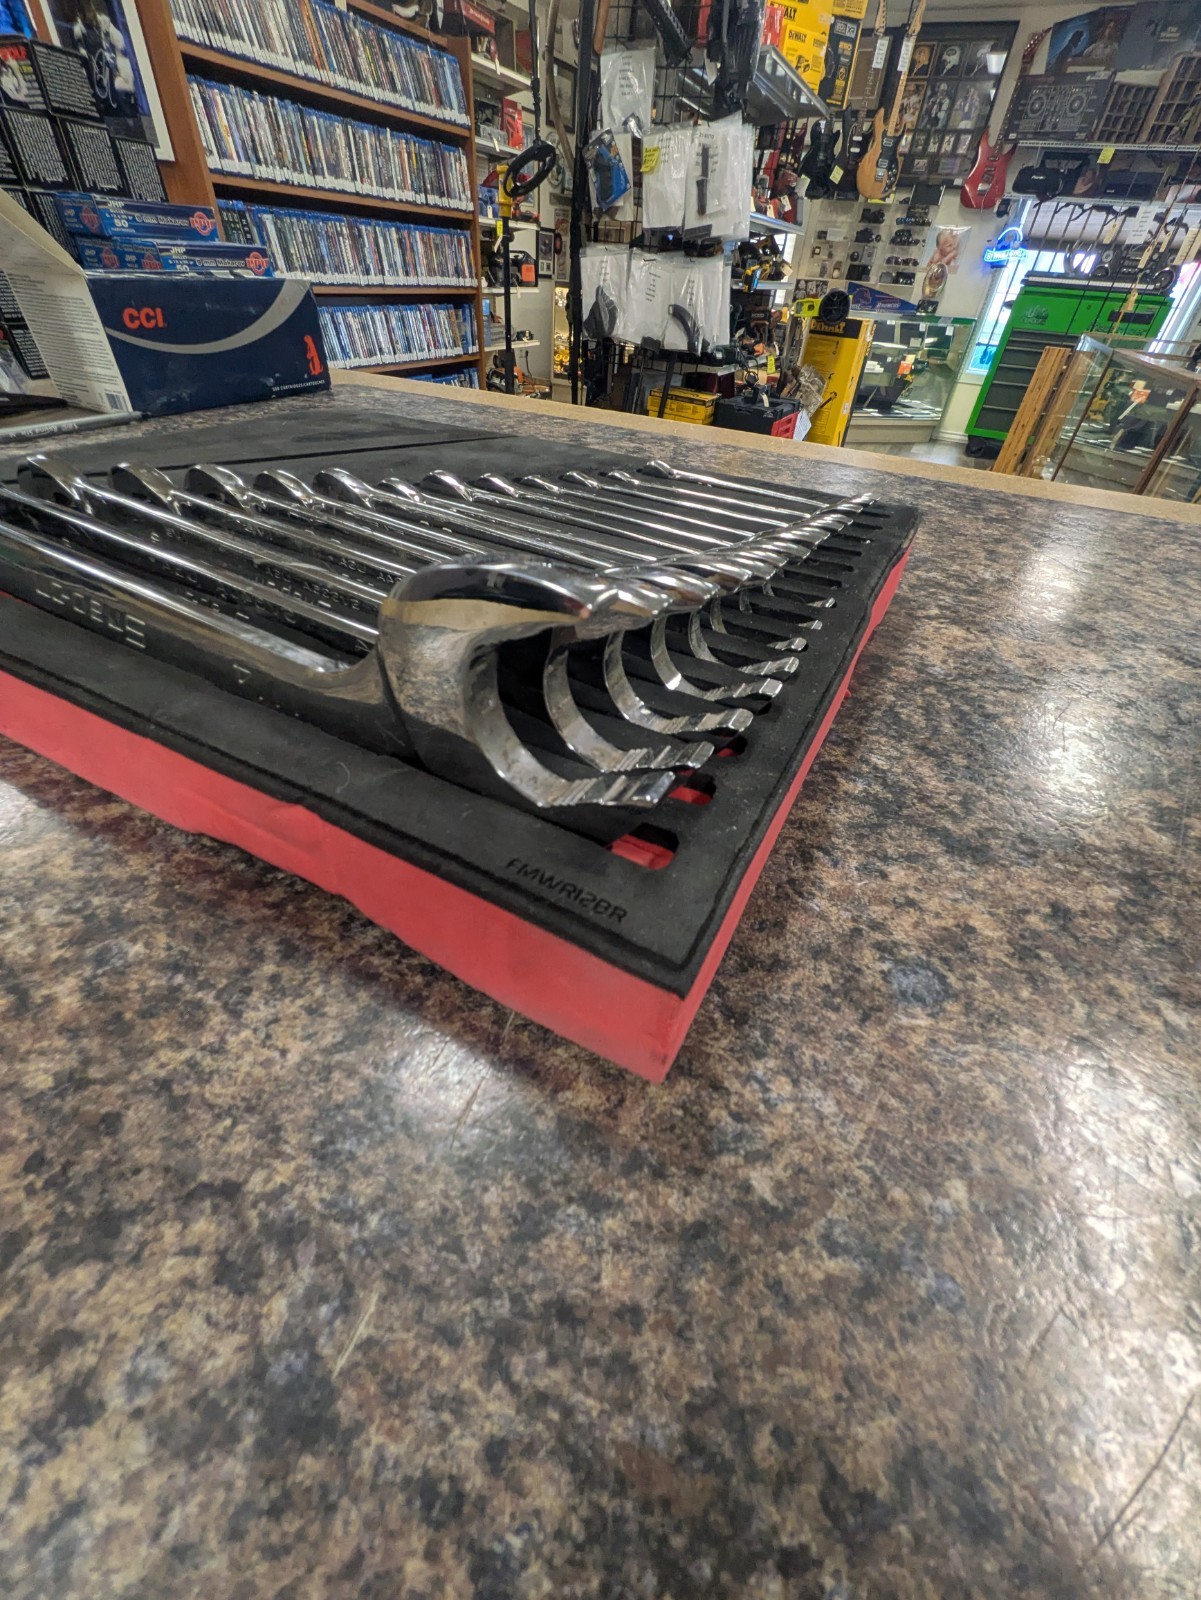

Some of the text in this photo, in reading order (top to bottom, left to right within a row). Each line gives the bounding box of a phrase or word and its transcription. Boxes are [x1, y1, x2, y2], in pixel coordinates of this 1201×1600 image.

[158, 215, 190, 227] Makarov
[217, 258, 246, 267] Makarov
[122, 306, 164, 330] CCI
[506, 858, 628, 924] FMWR12BR
